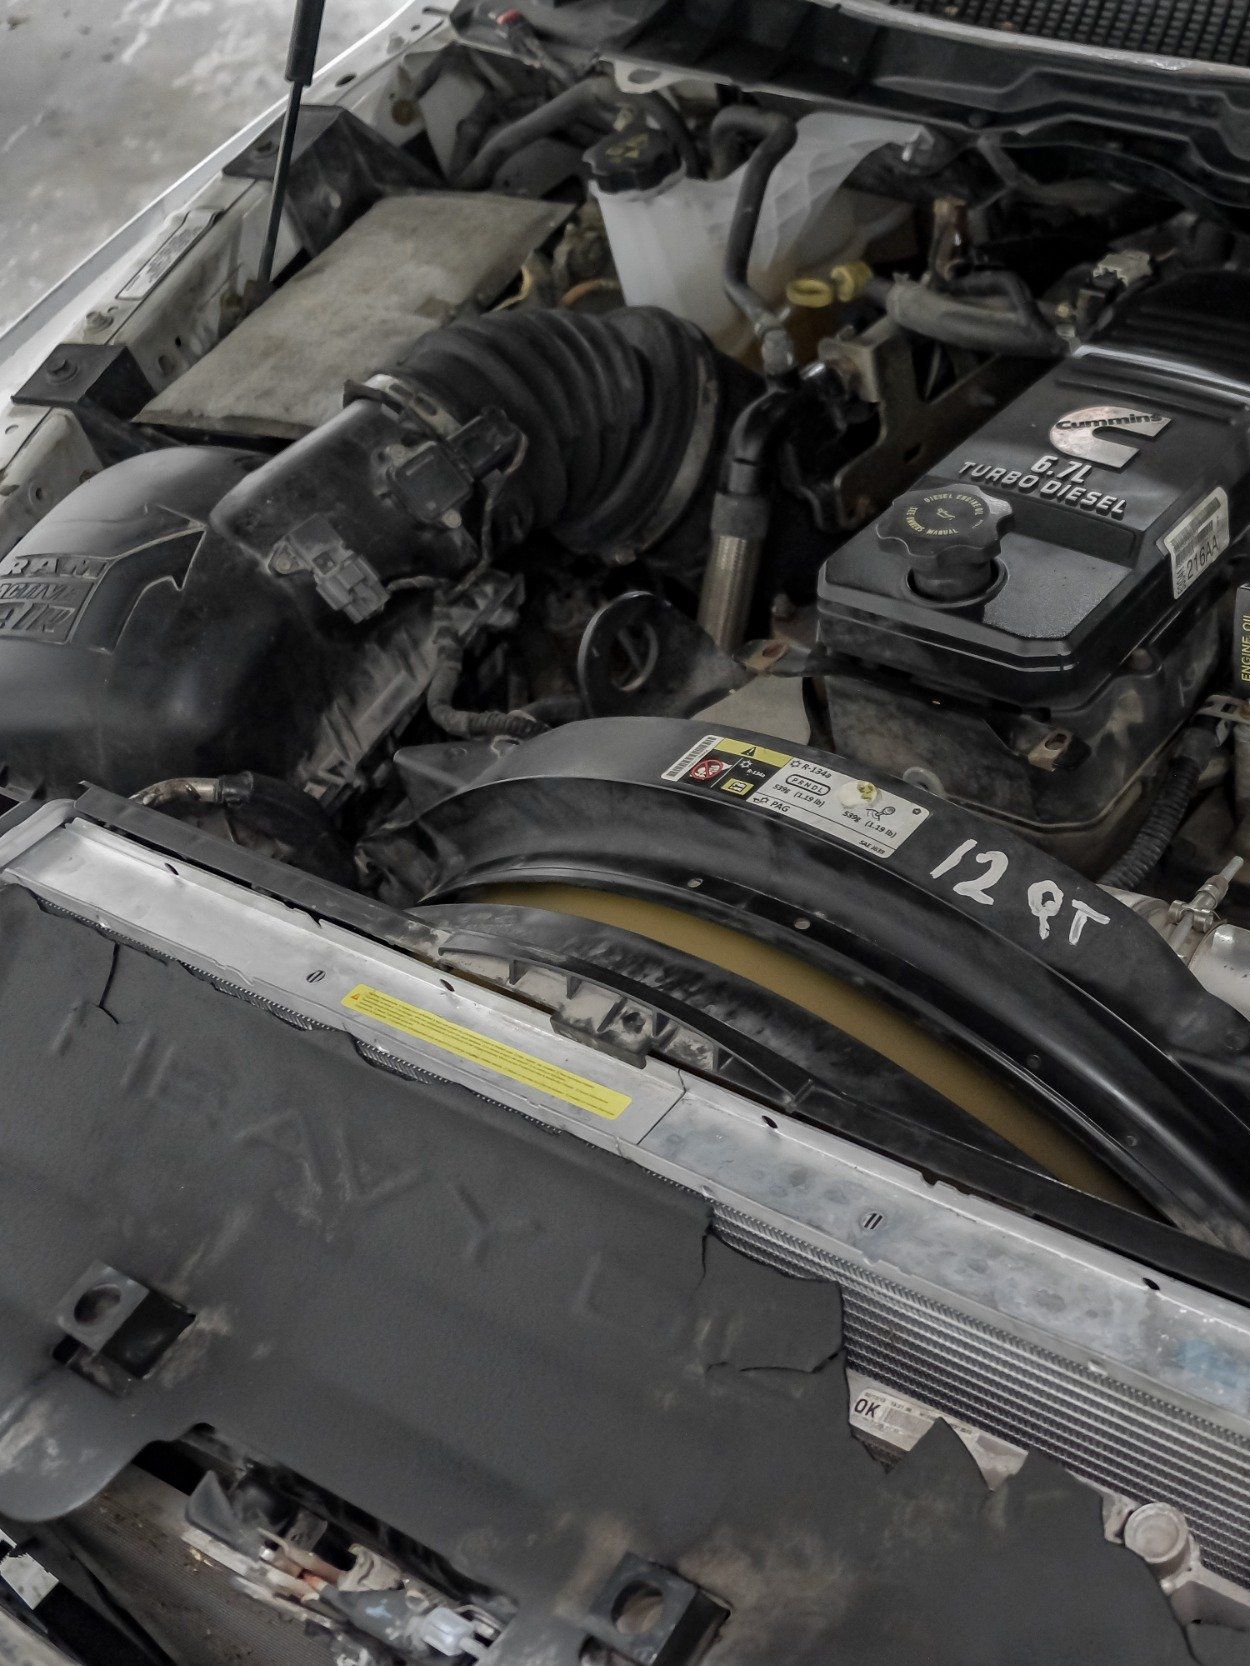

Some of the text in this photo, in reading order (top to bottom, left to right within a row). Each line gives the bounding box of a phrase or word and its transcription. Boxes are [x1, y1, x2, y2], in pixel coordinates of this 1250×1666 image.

[1056, 413, 1163, 430] Cummins
[1030, 455, 1092, 485] 6.7L
[958, 461, 1127, 519] TURBO DIESEL
[2, 558, 108, 578] RAM
[801, 763, 832, 779] R-134a
[772, 784, 791, 795] 539g
[793, 791, 815, 805] (1.19
[770, 800, 791, 813] PAG
[842, 810, 861, 823] 539g
[864, 820, 886, 834] (1.19
[930, 838, 1111, 946] 12 QT
[854, 1398, 881, 1418] OK
